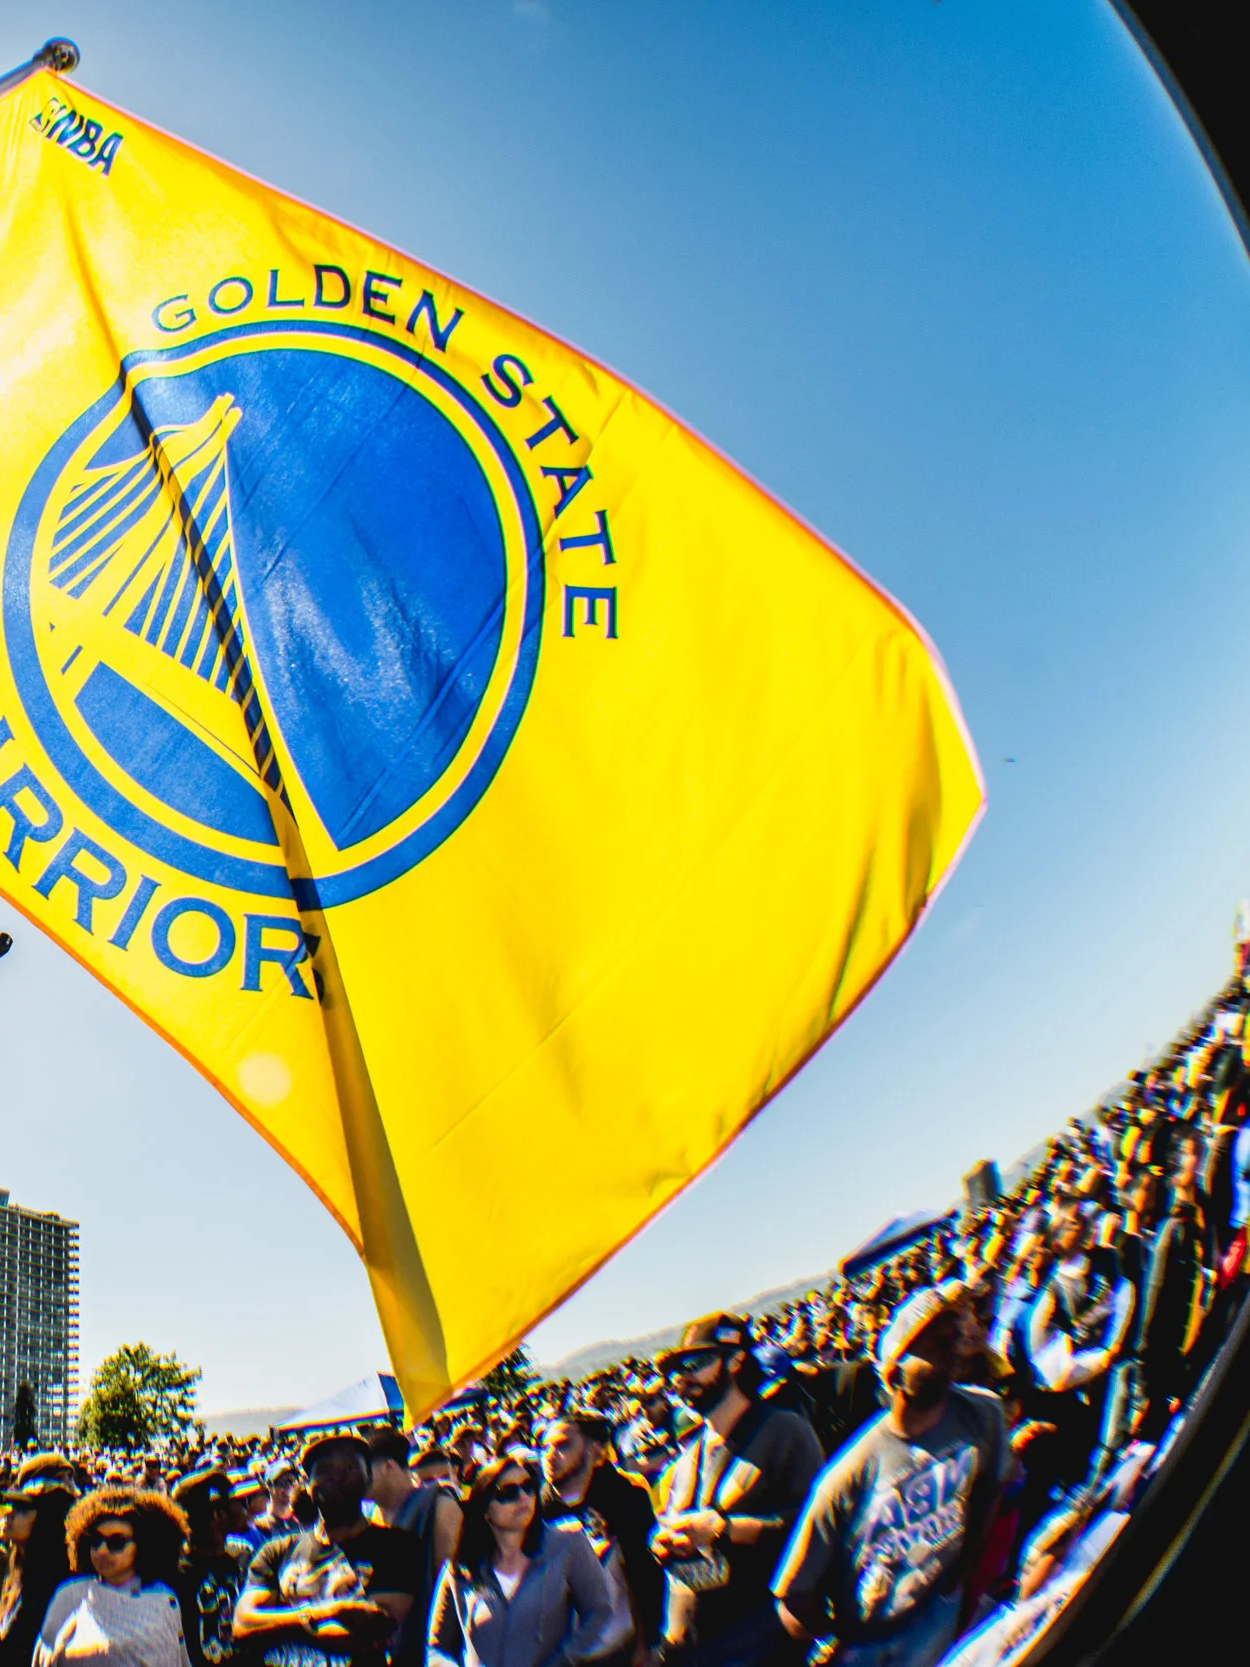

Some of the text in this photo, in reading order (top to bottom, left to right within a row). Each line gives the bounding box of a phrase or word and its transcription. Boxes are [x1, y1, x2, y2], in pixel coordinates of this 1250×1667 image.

[45, 108, 124, 177] NBA
[152, 263, 618, 640] GOLDEN STATE
